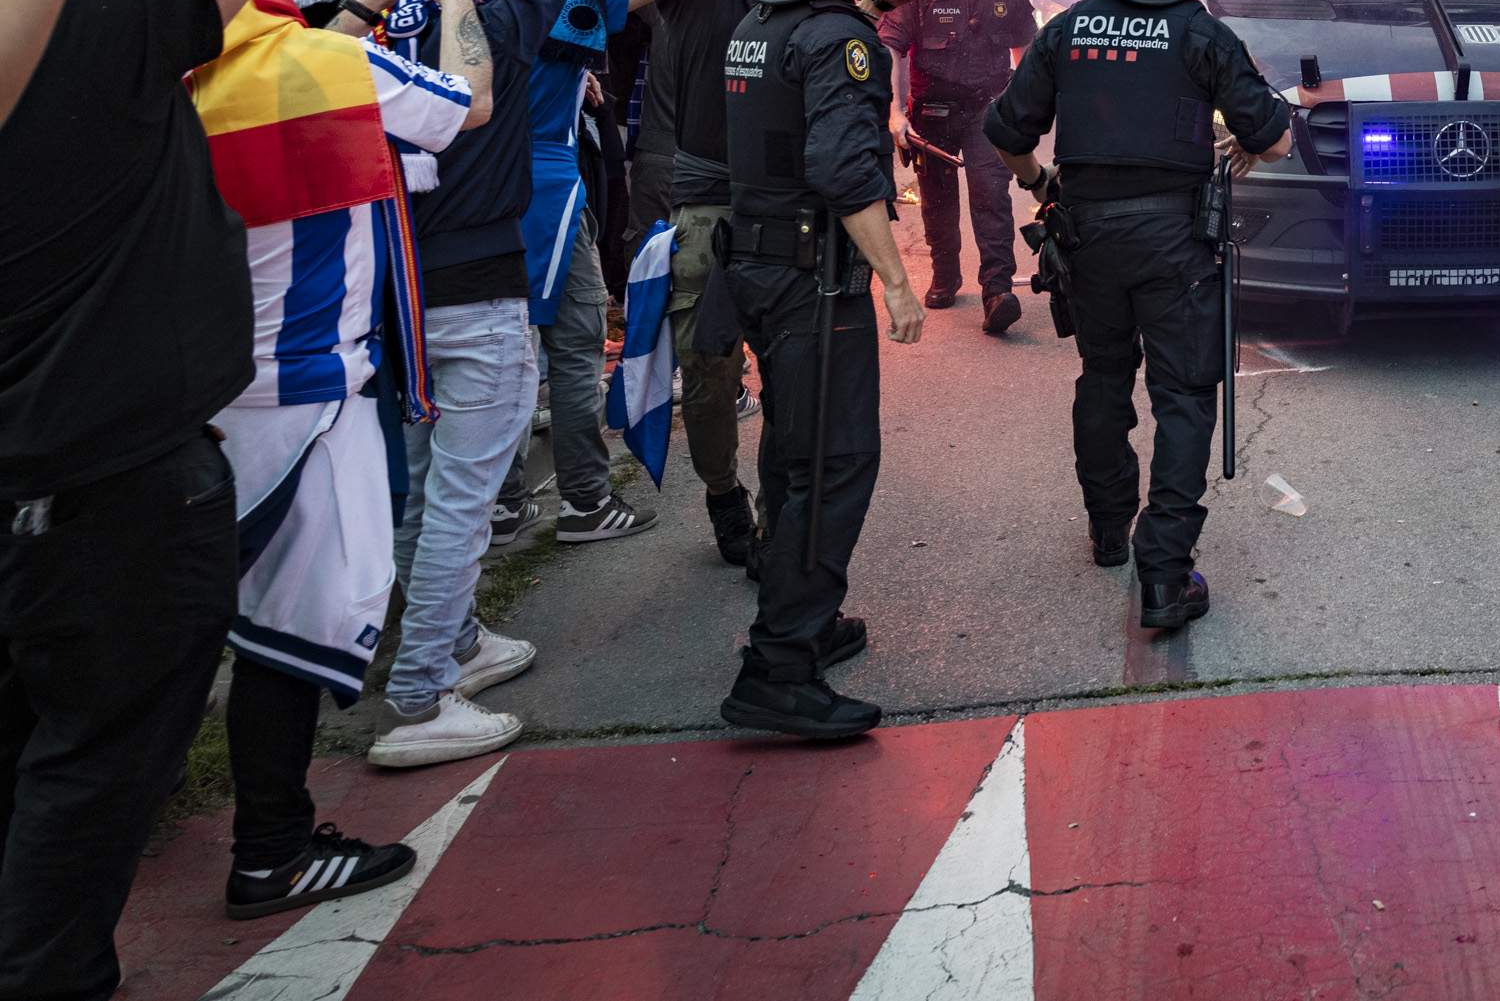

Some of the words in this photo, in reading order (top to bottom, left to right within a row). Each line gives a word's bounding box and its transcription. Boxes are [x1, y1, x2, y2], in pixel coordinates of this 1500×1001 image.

[932, 7, 961, 15] POLICIA
[1073, 14, 1170, 39] POLICIA
[1071, 36, 1110, 47] mossos
[725, 39, 768, 64] POLICIA
